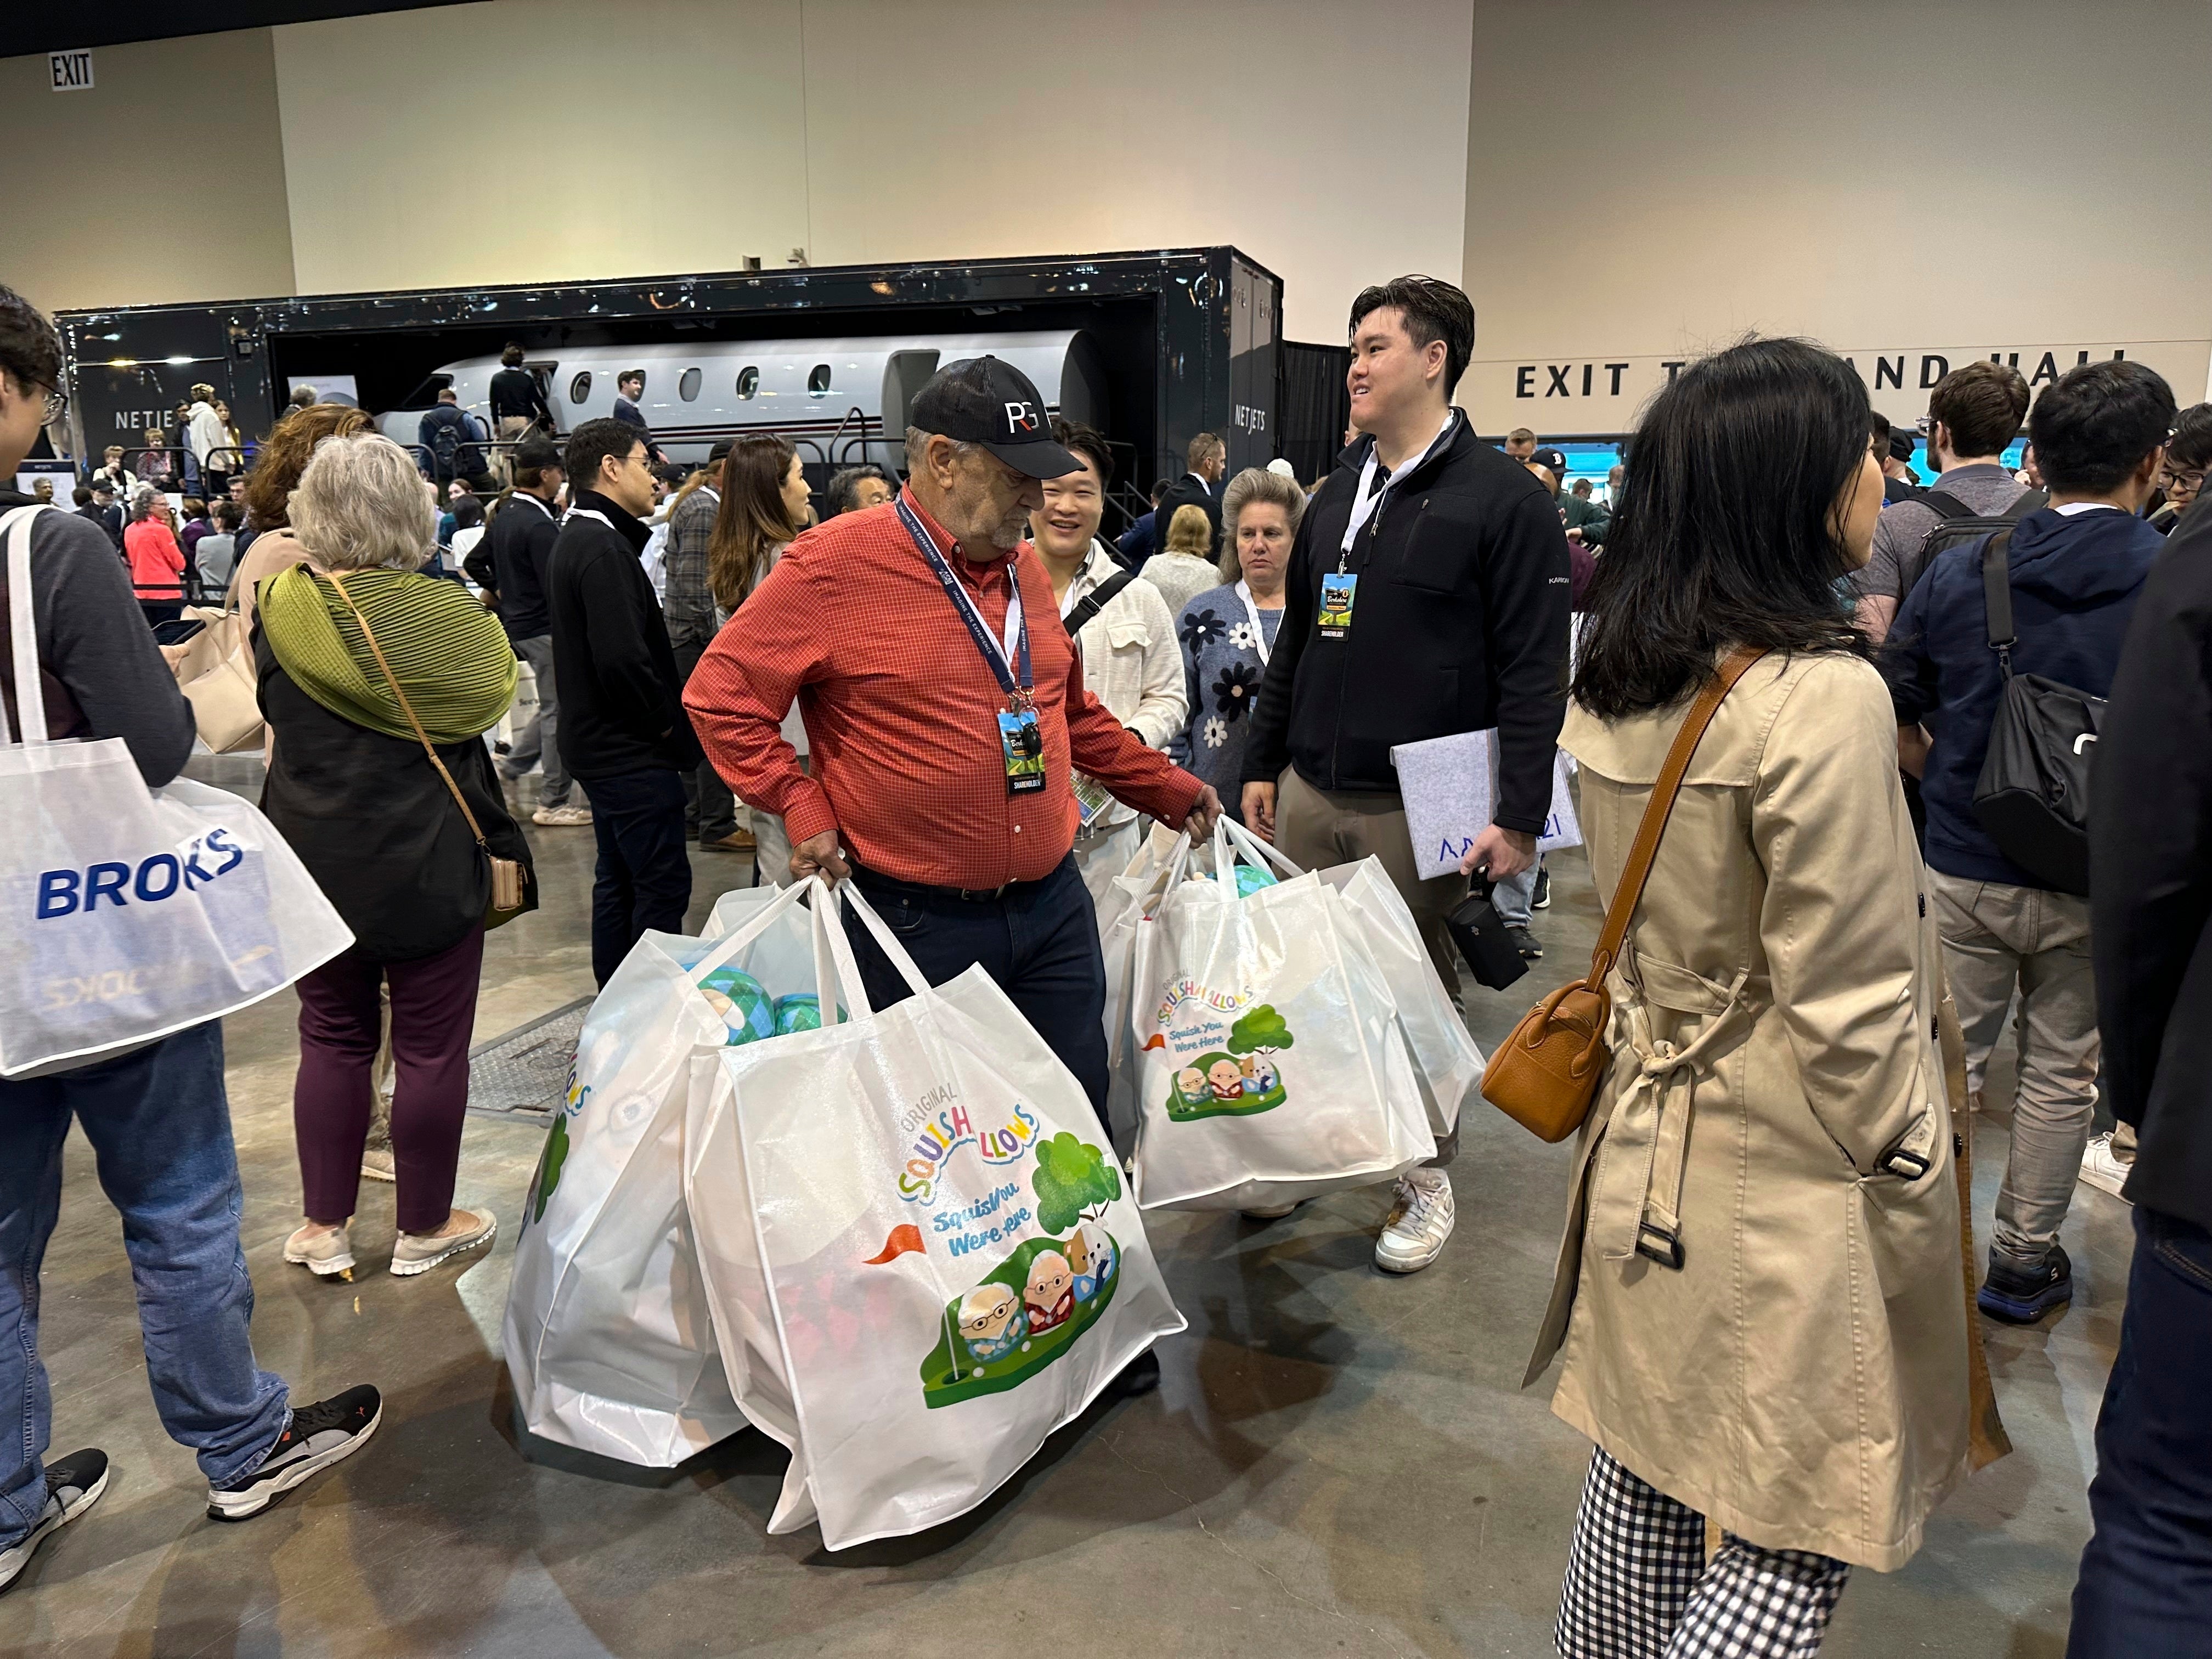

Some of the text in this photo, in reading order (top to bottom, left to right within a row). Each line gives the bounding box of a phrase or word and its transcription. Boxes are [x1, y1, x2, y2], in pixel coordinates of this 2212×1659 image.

[52, 53, 89, 86] EXIT
[1516, 364, 1629, 398] EXIT
[115, 409, 173, 430] NETJE
[1235, 404, 1266, 436] NETJETS
[1553, 453, 1562, 465] B
[910, 522, 918, 533] THE
[916, 531, 939, 563] EXPERIENCE
[952, 590, 992, 655] IMAGINE THE EXPERIENCE
[1169, 1022, 1224, 1041] Squish You
[1175, 1036, 1224, 1053] Were Here
[900, 1082, 958, 1132] ORIGINAL
[898, 1103, 1035, 1198] SQUISHLLOWS
[948, 1227, 1003, 1257] Were
